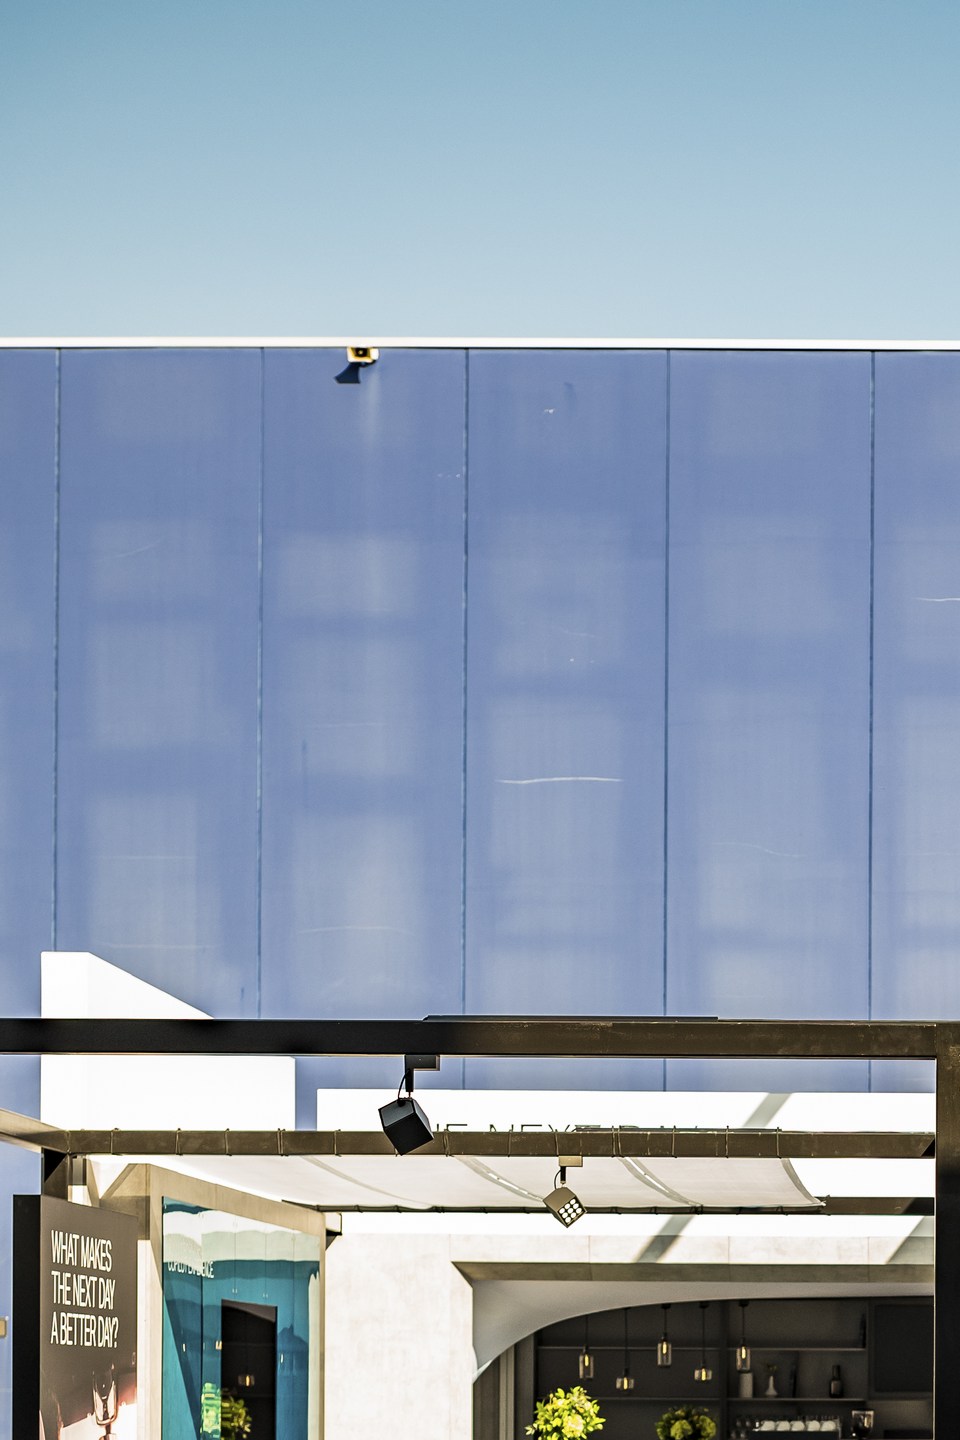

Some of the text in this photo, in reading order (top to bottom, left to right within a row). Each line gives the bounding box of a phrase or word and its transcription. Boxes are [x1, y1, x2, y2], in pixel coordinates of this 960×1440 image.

[51, 1229, 112, 1272] WHAT MAKES
[51, 1270, 115, 1310] THE NEXT DAY
[50, 1311, 118, 1349] A BETTER DAY?
